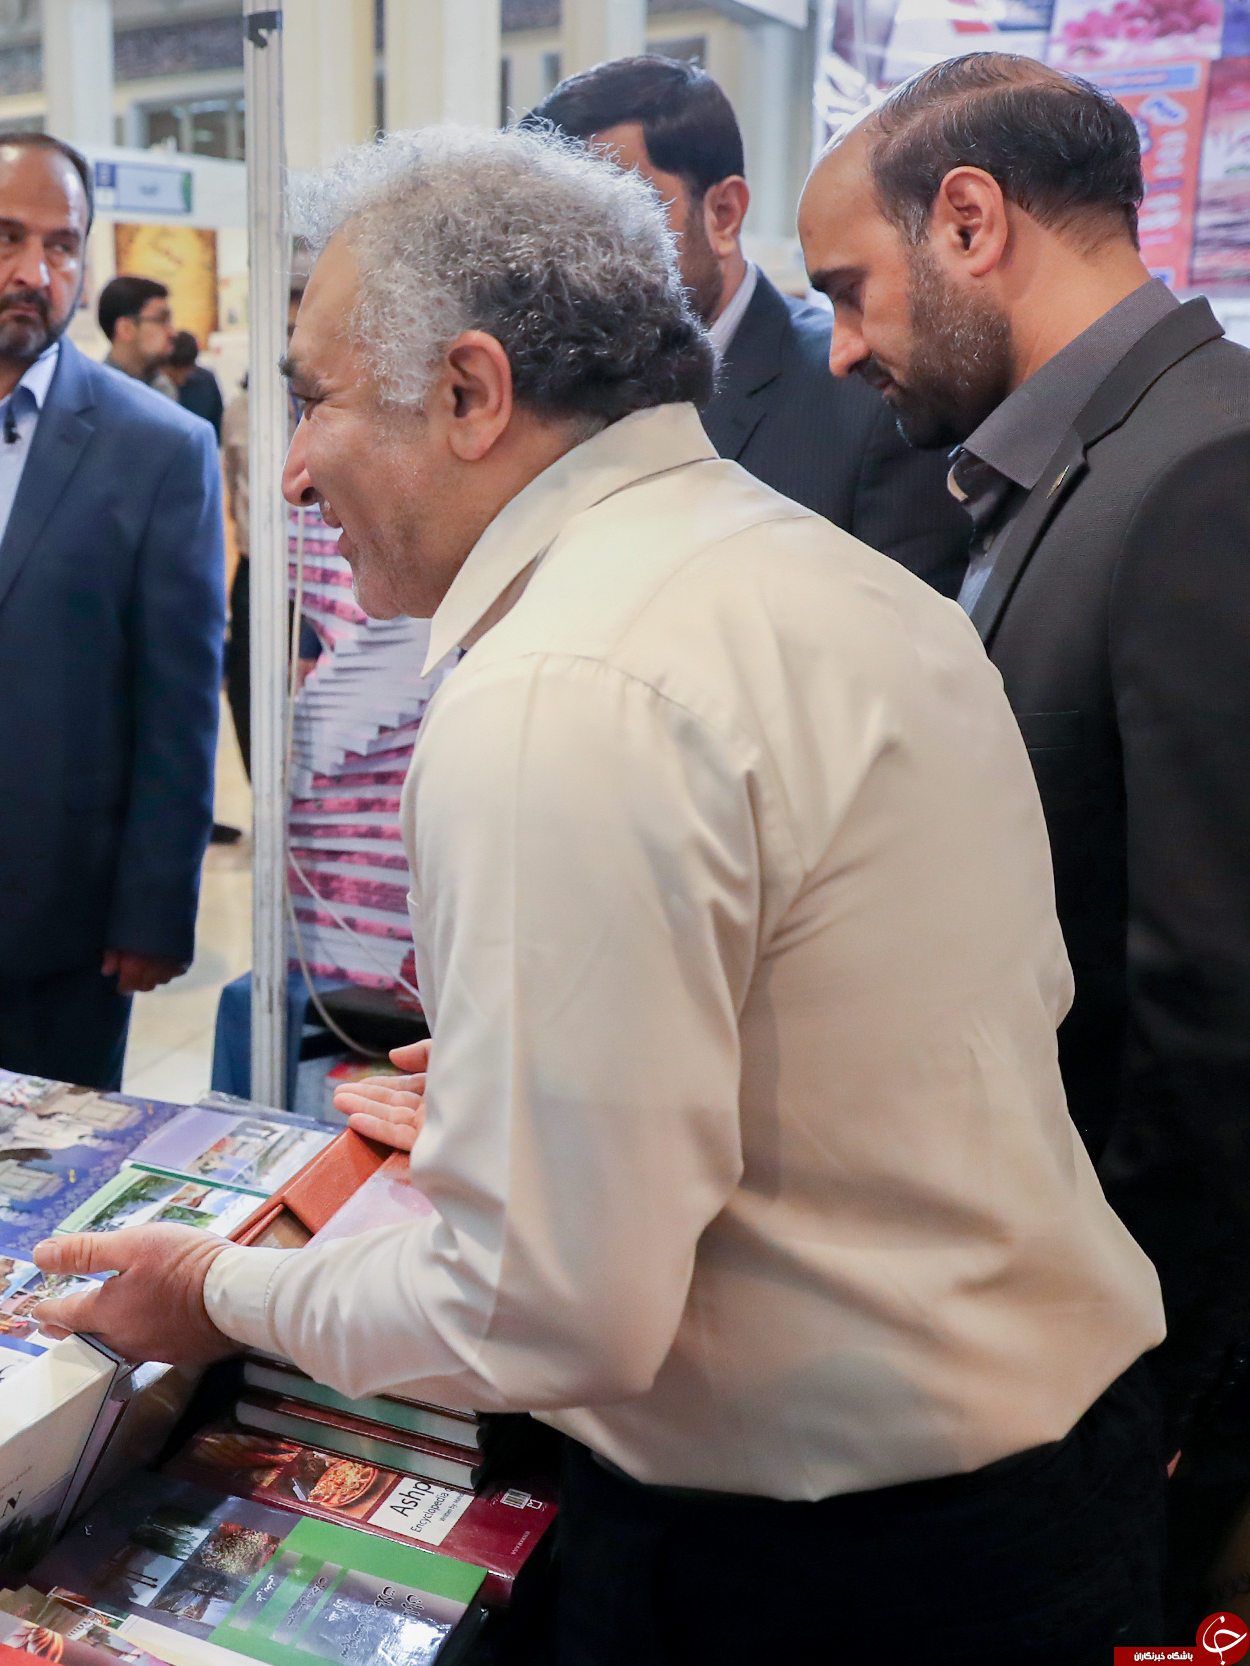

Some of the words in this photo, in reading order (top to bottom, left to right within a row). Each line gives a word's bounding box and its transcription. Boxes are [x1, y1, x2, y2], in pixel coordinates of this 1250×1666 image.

[388, 1476, 434, 1518] Ashp
[410, 1490, 450, 1534] Encyclopedia
[255, 1590, 268, 1603] علی
[260, 1575, 275, 1592] بخشی
